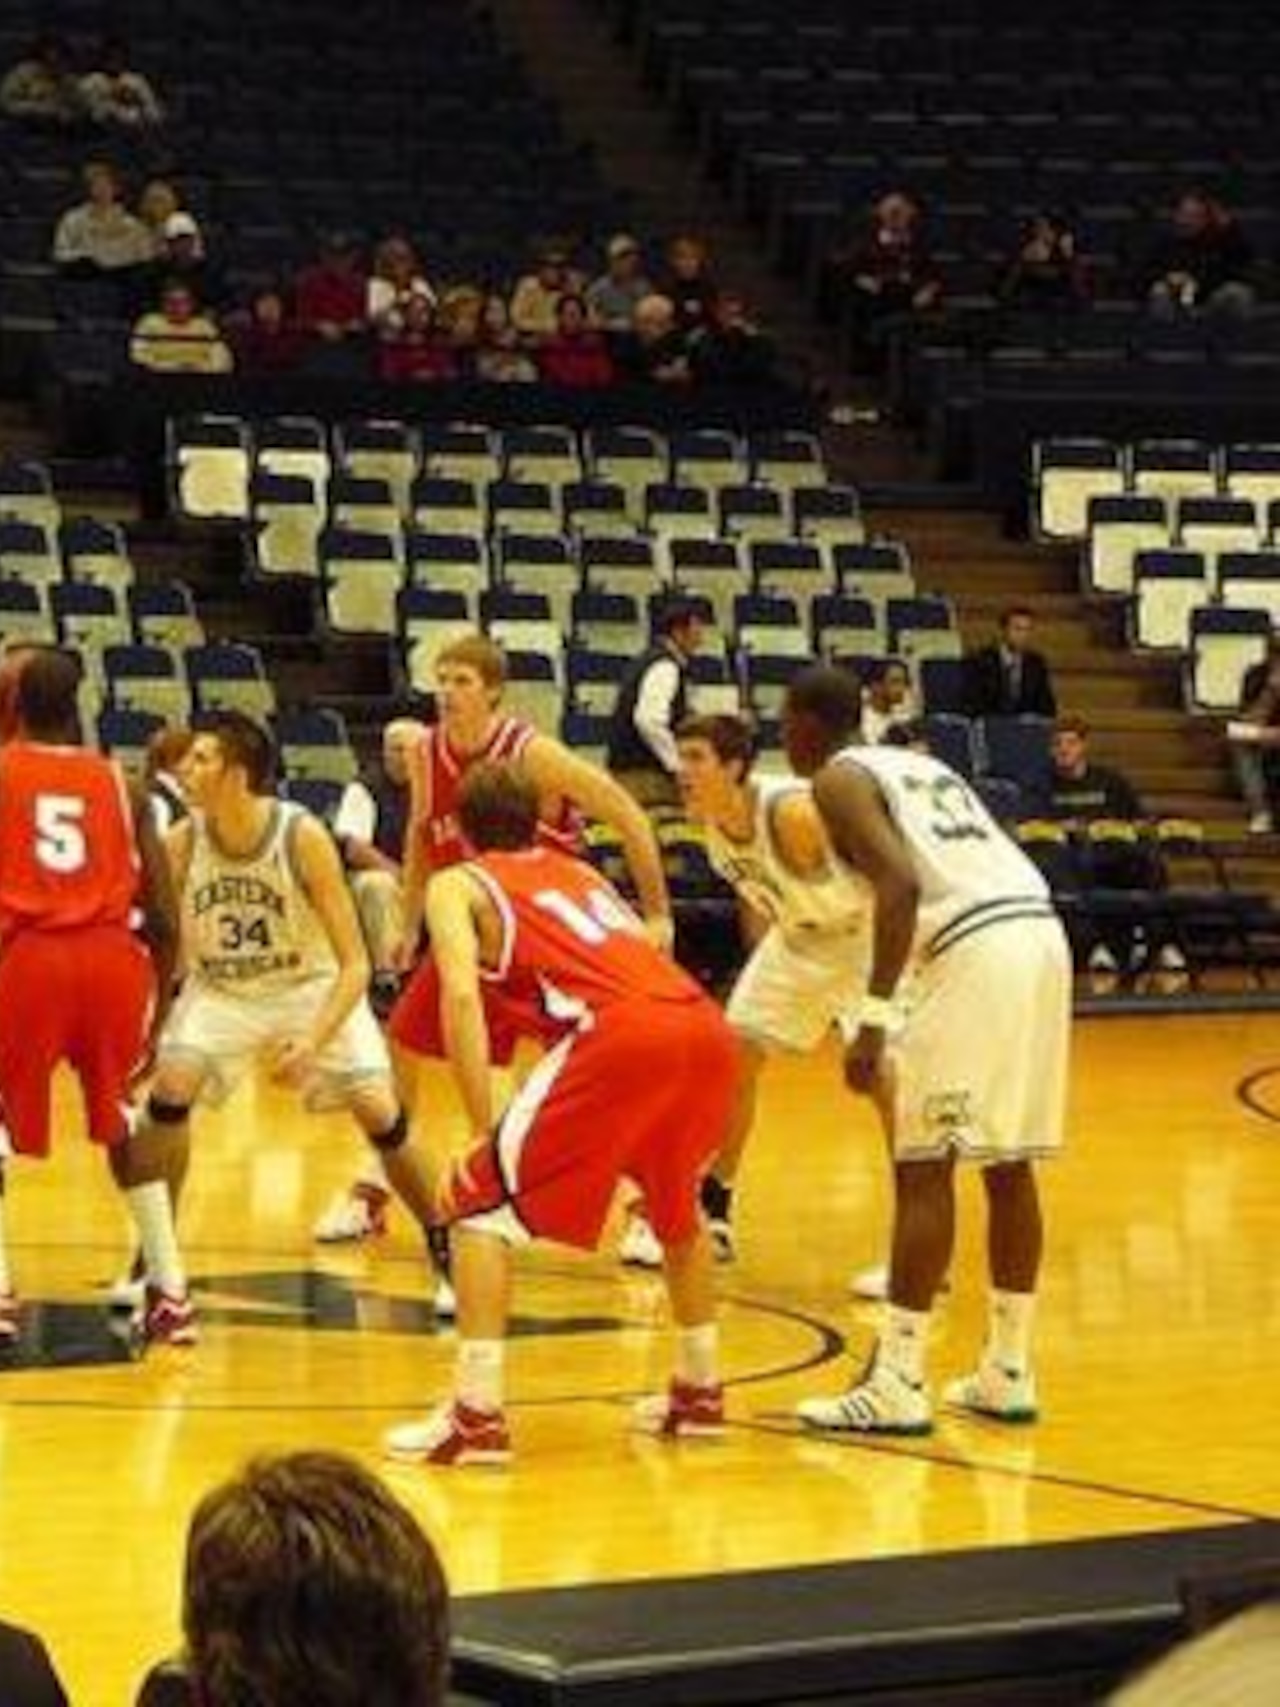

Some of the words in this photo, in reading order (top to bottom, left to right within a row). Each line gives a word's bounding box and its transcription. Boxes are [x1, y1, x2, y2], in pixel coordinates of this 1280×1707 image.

[33, 793, 87, 874] 5
[193, 876, 286, 918] EASTERN
[219, 914, 271, 950] 34
